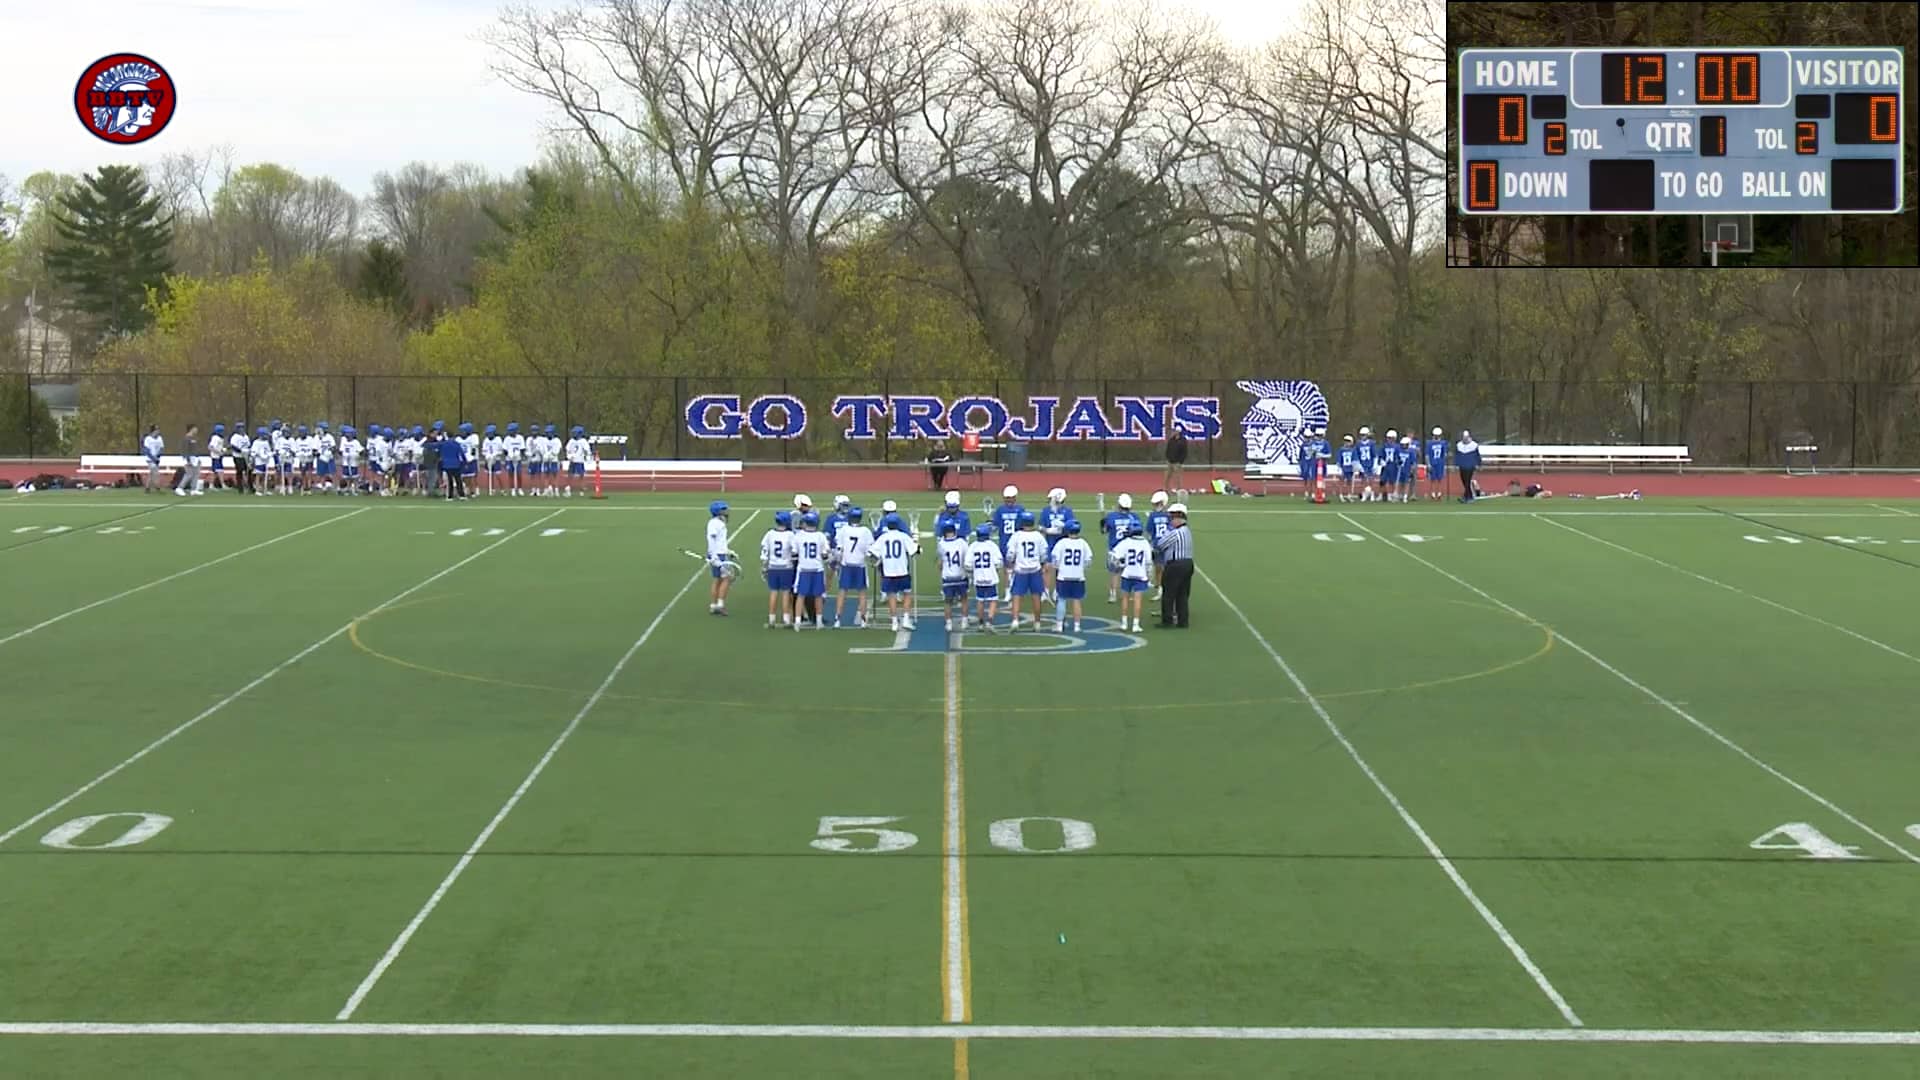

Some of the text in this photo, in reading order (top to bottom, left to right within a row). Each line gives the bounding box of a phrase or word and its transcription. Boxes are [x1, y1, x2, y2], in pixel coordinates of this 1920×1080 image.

[1475, 61, 1558, 87] HOME
[1623, 56, 1759, 103] 12:00
[1795, 60, 1900, 86] VISITOR
[1498, 96, 1524, 143] 0
[1869, 95, 1897, 142] 0
[1546, 123, 1603, 154] 2 TOL
[1645, 118, 1725, 155] QTR 1
[1755, 123, 1816, 154] TOL 2
[1469, 163, 1568, 208] 0 DOWN
[1661, 172, 1723, 197] TO GO
[1742, 172, 1826, 197] BALL ON
[686, 394, 1223, 442] GO TROJANS
[1004, 520, 1015, 534] 21
[774, 540, 783, 558] 2
[803, 542, 818, 559] 18
[849, 537, 859, 554] 7
[885, 540, 902, 559] 10
[1021, 541, 1035, 558] 12
[1064, 549, 1081, 566] 28
[1128, 549, 1144, 566] 24
[945, 551, 960, 568] 14
[974, 552, 990, 569] 29
